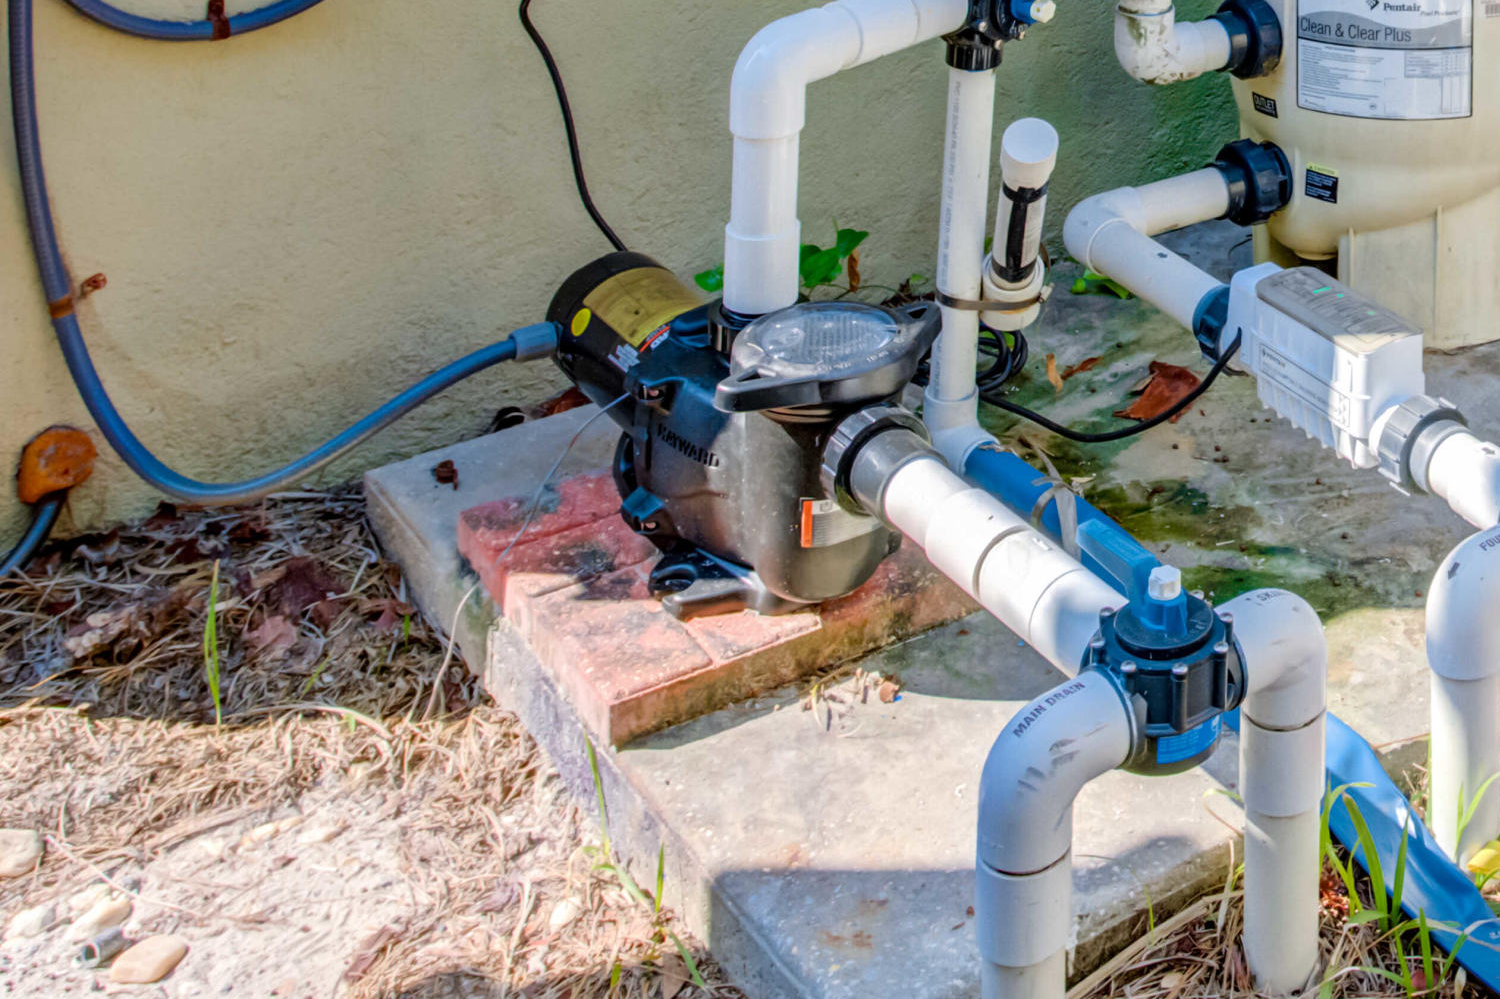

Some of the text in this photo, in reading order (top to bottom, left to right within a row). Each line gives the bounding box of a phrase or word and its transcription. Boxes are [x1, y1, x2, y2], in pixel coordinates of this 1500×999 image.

[1383, 2, 1421, 12] Pentair
[1300, 17, 1412, 42] Clean & Clear Plus
[657, 423, 720, 467] HAYWARD
[1013, 682, 1086, 737] MAIN DRAIN
